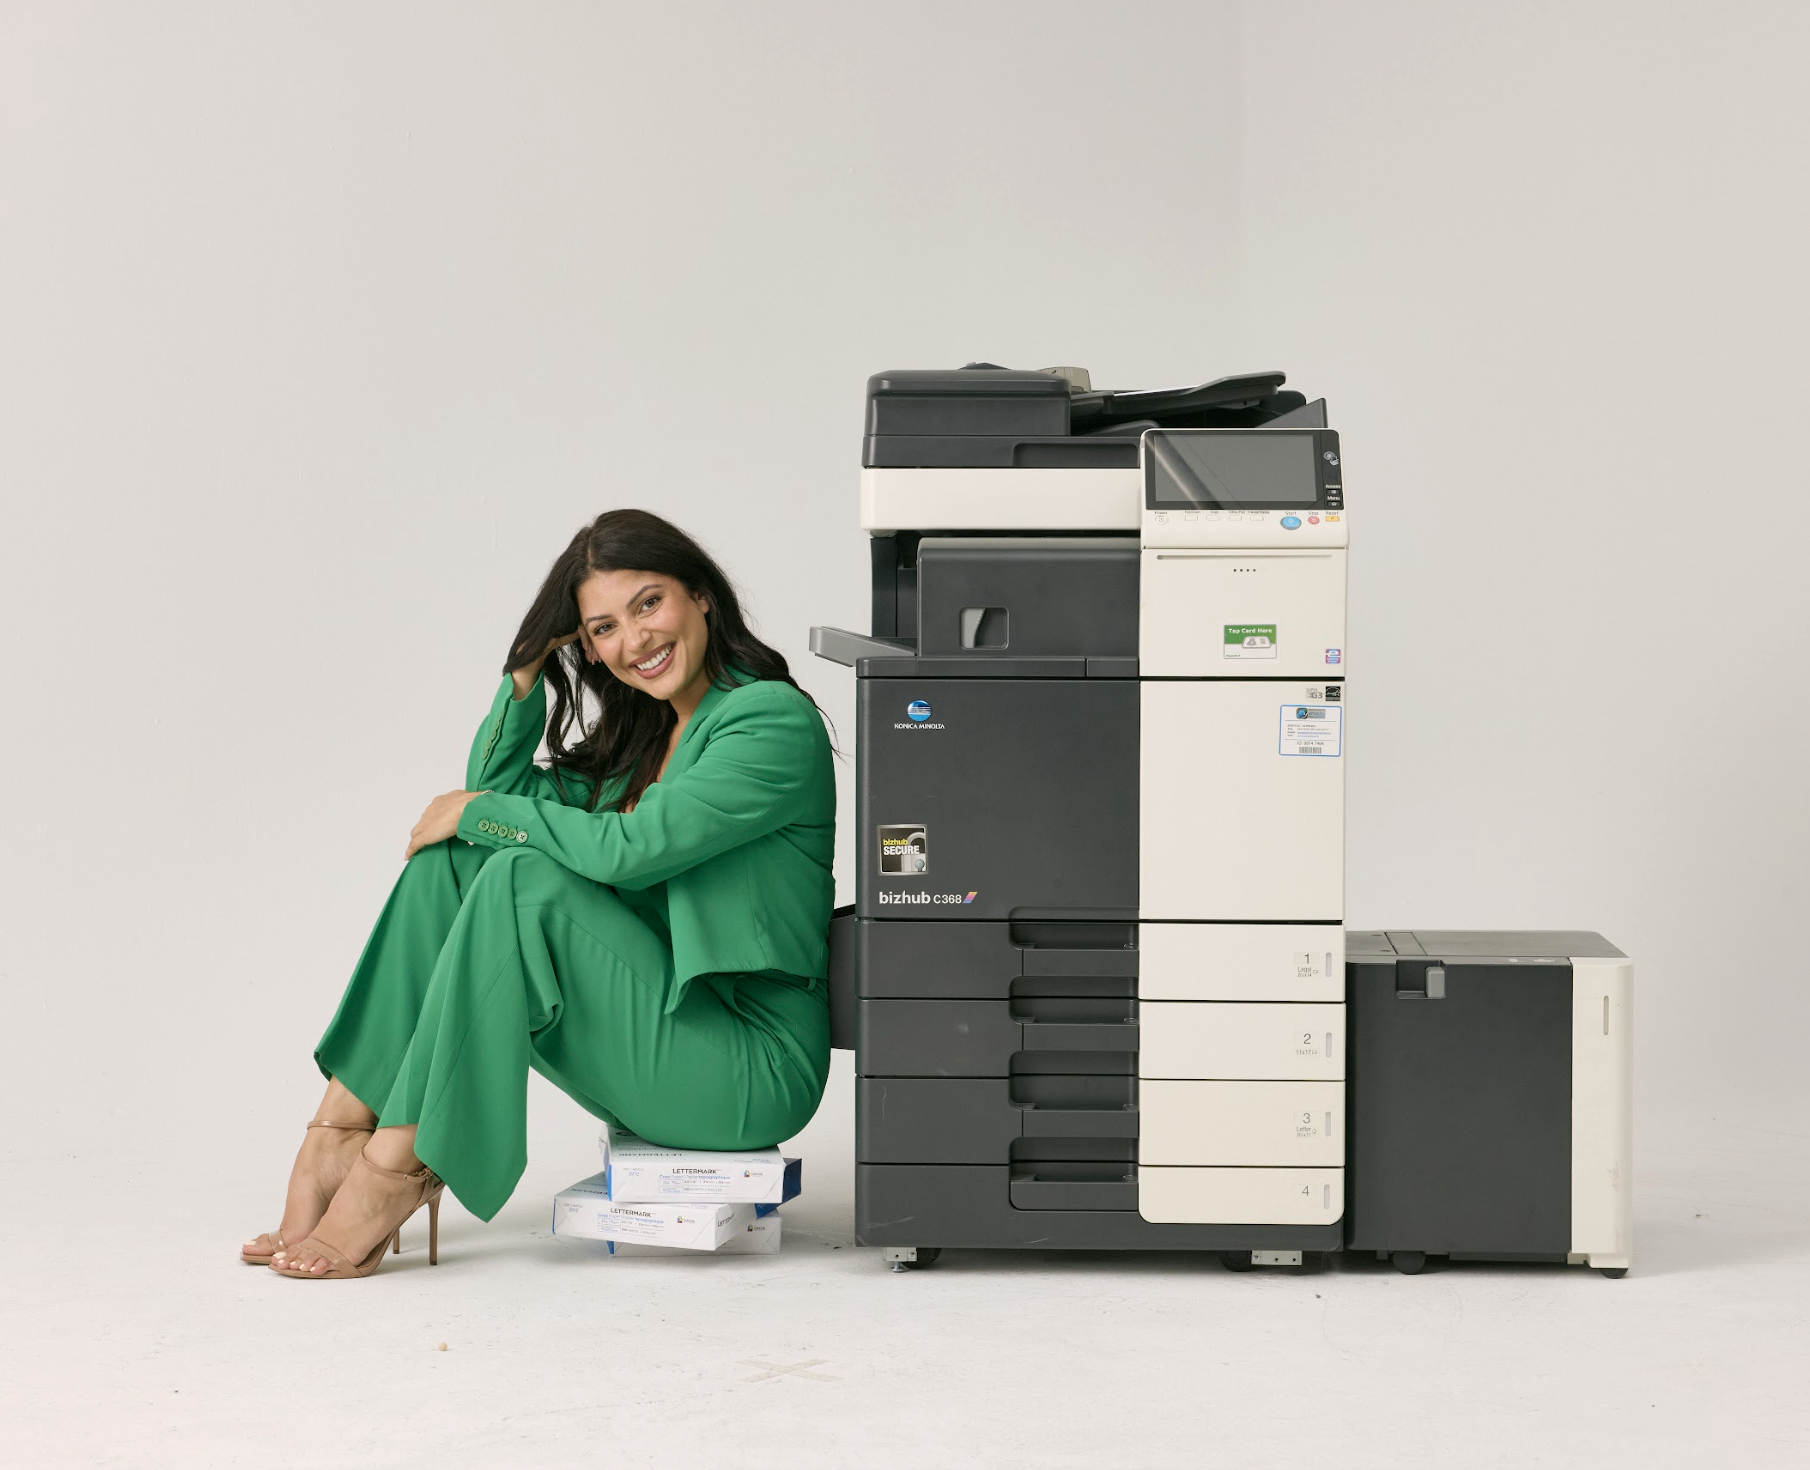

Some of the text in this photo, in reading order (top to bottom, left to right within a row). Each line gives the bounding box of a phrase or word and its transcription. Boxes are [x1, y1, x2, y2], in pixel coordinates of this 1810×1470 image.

[883, 846, 920, 856] SECURE
[879, 891, 962, 904] bizhub C368
[1304, 953, 1310, 964] 1
[1303, 1033, 1311, 1044] 2
[1302, 1112, 1311, 1124] 3
[1302, 1186, 1310, 1196] 4
